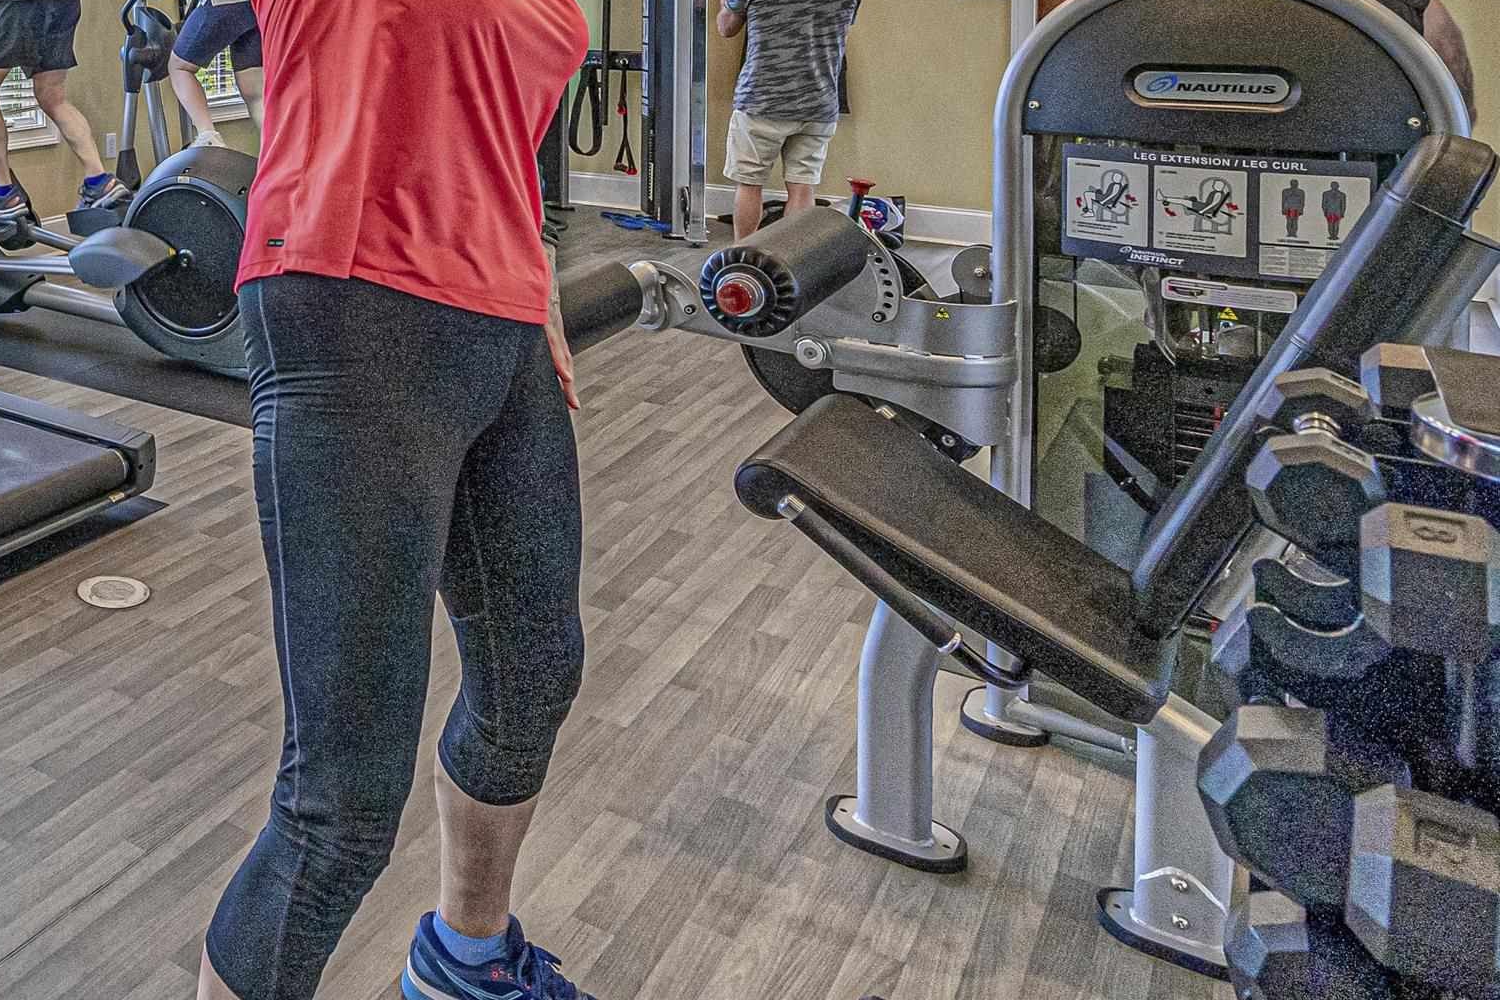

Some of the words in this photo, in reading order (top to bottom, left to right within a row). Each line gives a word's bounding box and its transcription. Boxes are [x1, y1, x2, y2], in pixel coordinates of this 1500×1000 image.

[1177, 83, 1277, 94] NAUTILUS
[1133, 152, 1157, 162] LEG
[1161, 154, 1231, 168] EXTENSION
[1243, 160, 1268, 169] LEG
[1272, 161, 1308, 171] CURL
[1130, 253, 1185, 265] INSTINCT
